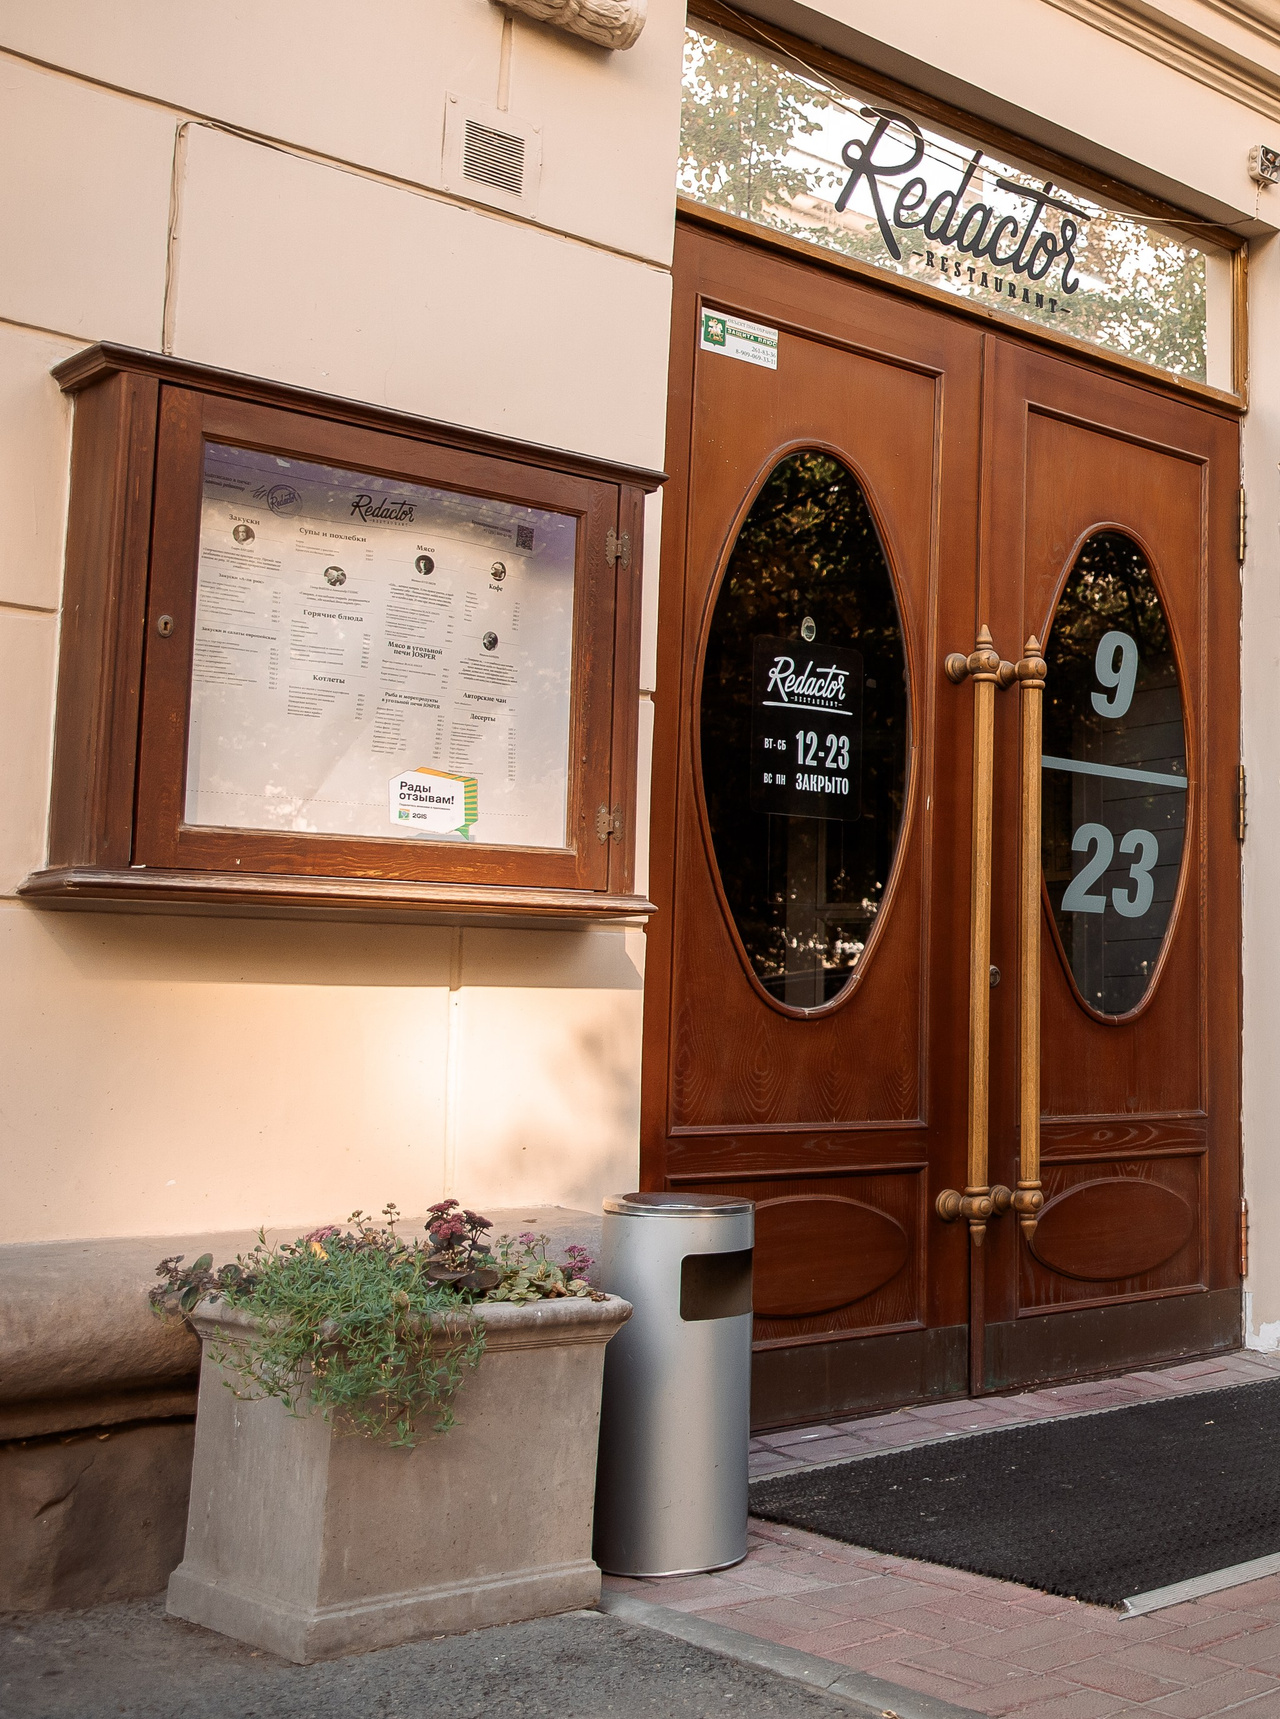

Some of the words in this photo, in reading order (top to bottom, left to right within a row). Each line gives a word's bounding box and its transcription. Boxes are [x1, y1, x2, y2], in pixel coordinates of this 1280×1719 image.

[835, 107, 1092, 295] Redactor
[925, 250, 1058, 314] RESTAURANT
[350, 494, 417, 522] Redactor
[229, 513, 260, 526] Закуски
[299, 527, 320, 536] Супы
[330, 533, 367, 543] похлебки
[416, 545, 436, 553] Мясо
[488, 584, 503, 592] Кофе
[303, 609, 337, 619] Горячие
[338, 613, 364, 622] блюда
[387, 641, 406, 649] Мясо
[412, 645, 443, 655] угольной
[393, 649, 411, 657] печи
[412, 650, 436, 660] JOSPER
[313, 674, 345, 684] Котлеты
[767, 656, 850, 702] Redactor
[1090, 630, 1139, 719] 9
[463, 692, 495, 702] Авторские
[470, 713, 496, 722] Десерты
[795, 730, 850, 770] 12-23
[400, 781, 432, 793] Рады
[763, 772, 773, 784] ВС
[775, 773, 786, 786] ПН
[795, 772, 849, 795] ЗАКРЫТО
[399, 792, 455, 805] отзывам!
[412, 812, 428, 820] 2GIS
[1061, 822, 1159, 918] 23
